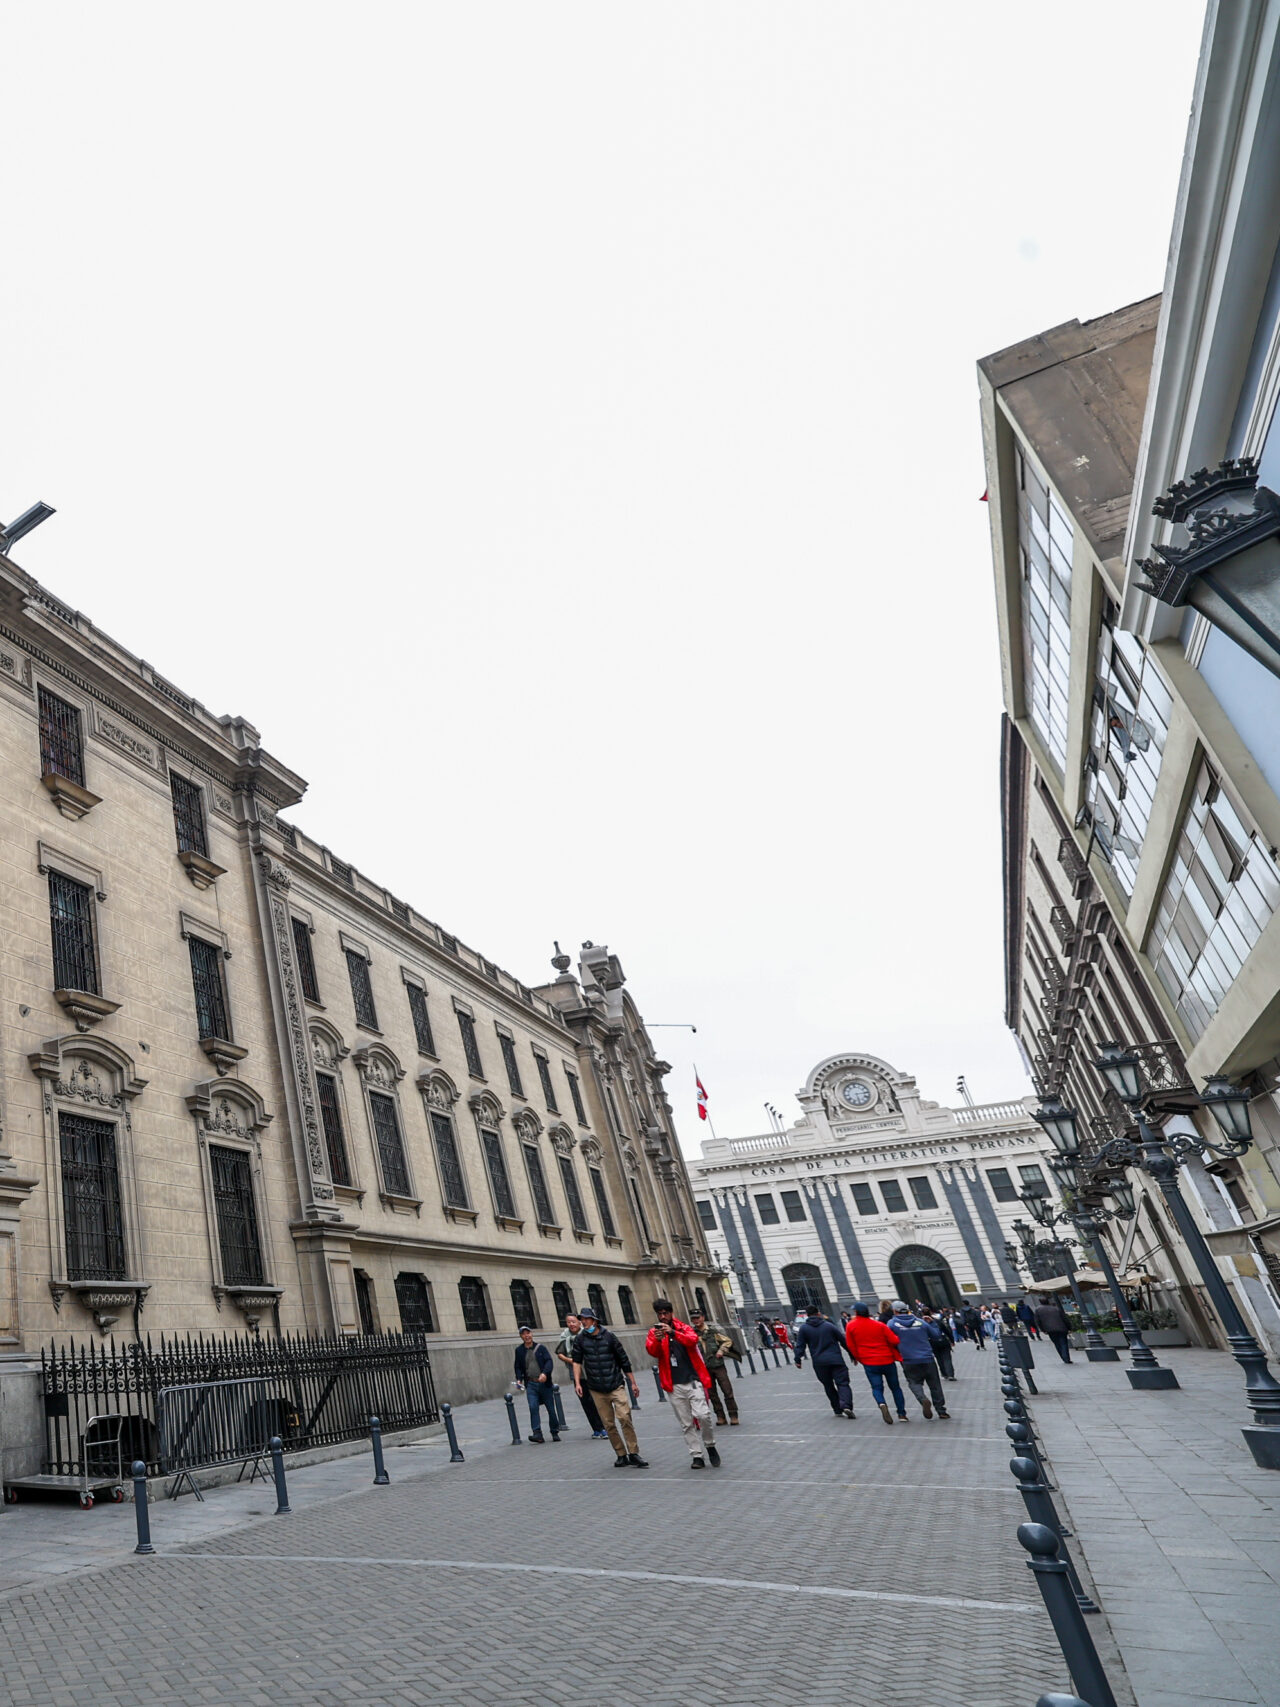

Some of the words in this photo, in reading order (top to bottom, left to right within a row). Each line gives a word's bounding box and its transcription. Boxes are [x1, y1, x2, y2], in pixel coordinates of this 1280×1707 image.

[751, 1166, 786, 1177] CASA
[806, 1161, 823, 1170] DE
[833, 1158, 851, 1167] LA
[861, 1145, 959, 1164] LITERATURA
[970, 1136, 1036, 1151] PERUANA
